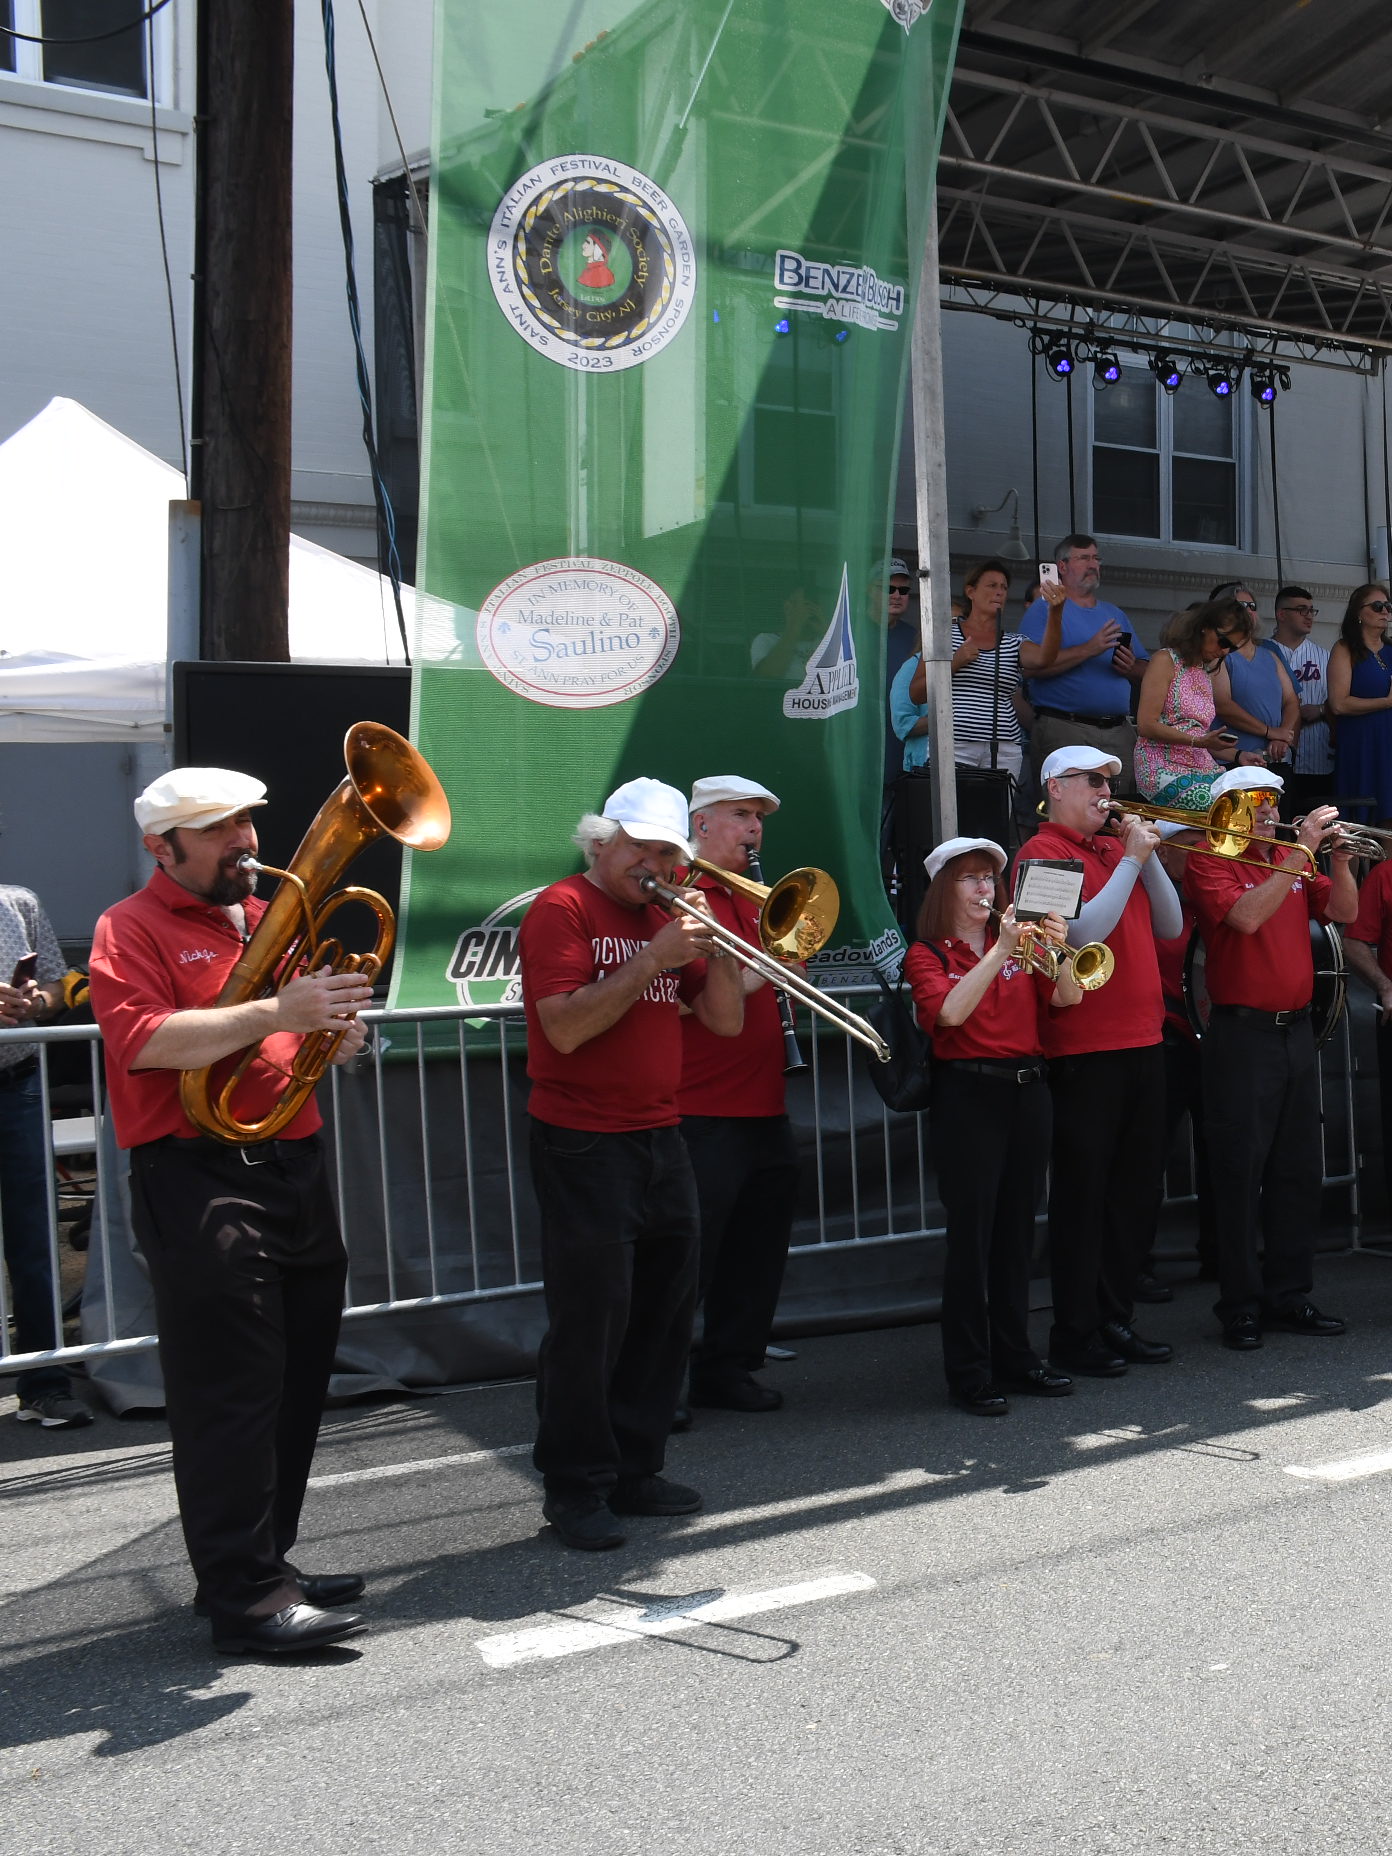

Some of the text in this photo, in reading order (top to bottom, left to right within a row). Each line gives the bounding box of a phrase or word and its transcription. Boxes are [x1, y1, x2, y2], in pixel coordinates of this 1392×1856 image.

[495, 159, 691, 358] SAINT ANN'S ITALIAN FESTIVAL BEER GARDEN SPONSOR
[540, 206, 649, 289] Dante Alighieri Society
[779, 254, 863, 298] BENZE
[548, 288, 582, 319] Jersey
[619, 298, 637, 317] NJ
[567, 352, 613, 369] 2023
[484, 569, 527, 614] ITALIAN
[535, 560, 595, 575] FESTIVAL
[602, 562, 656, 595] ZEPPOLE
[528, 579, 639, 612] IN MEMORY OF
[518, 609, 645, 628] Madeline & Pat
[529, 628, 641, 662] Saulino
[562, 674, 597, 687] PRAY
[600, 666, 627, 682] FOR
[628, 656, 645, 670] US
[451, 931, 522, 978] CIN
[807, 932, 900, 963] eadowlands
